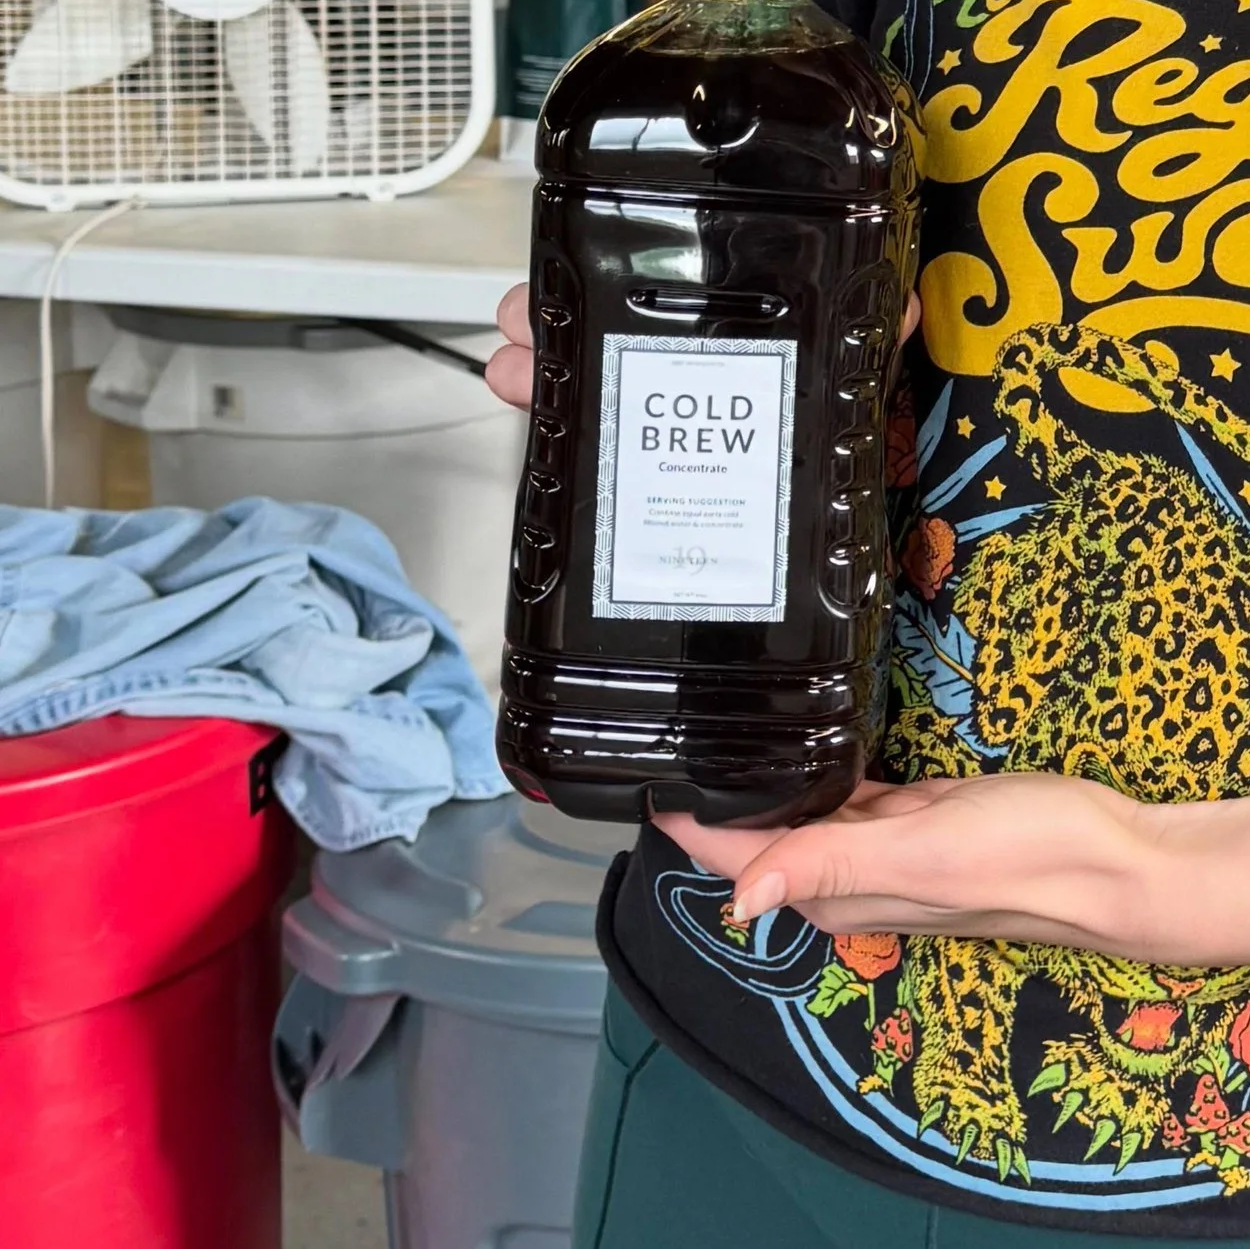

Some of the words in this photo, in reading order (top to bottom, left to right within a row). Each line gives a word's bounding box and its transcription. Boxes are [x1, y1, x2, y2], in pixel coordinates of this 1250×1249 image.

[644, 392, 754, 421] COLD
[641, 426, 756, 454] BREW
[658, 461, 728, 474] Concentrate
[647, 496, 686, 506] SERVING
[688, 497, 747, 507] SUGGESTION
[671, 546, 707, 576] 19
